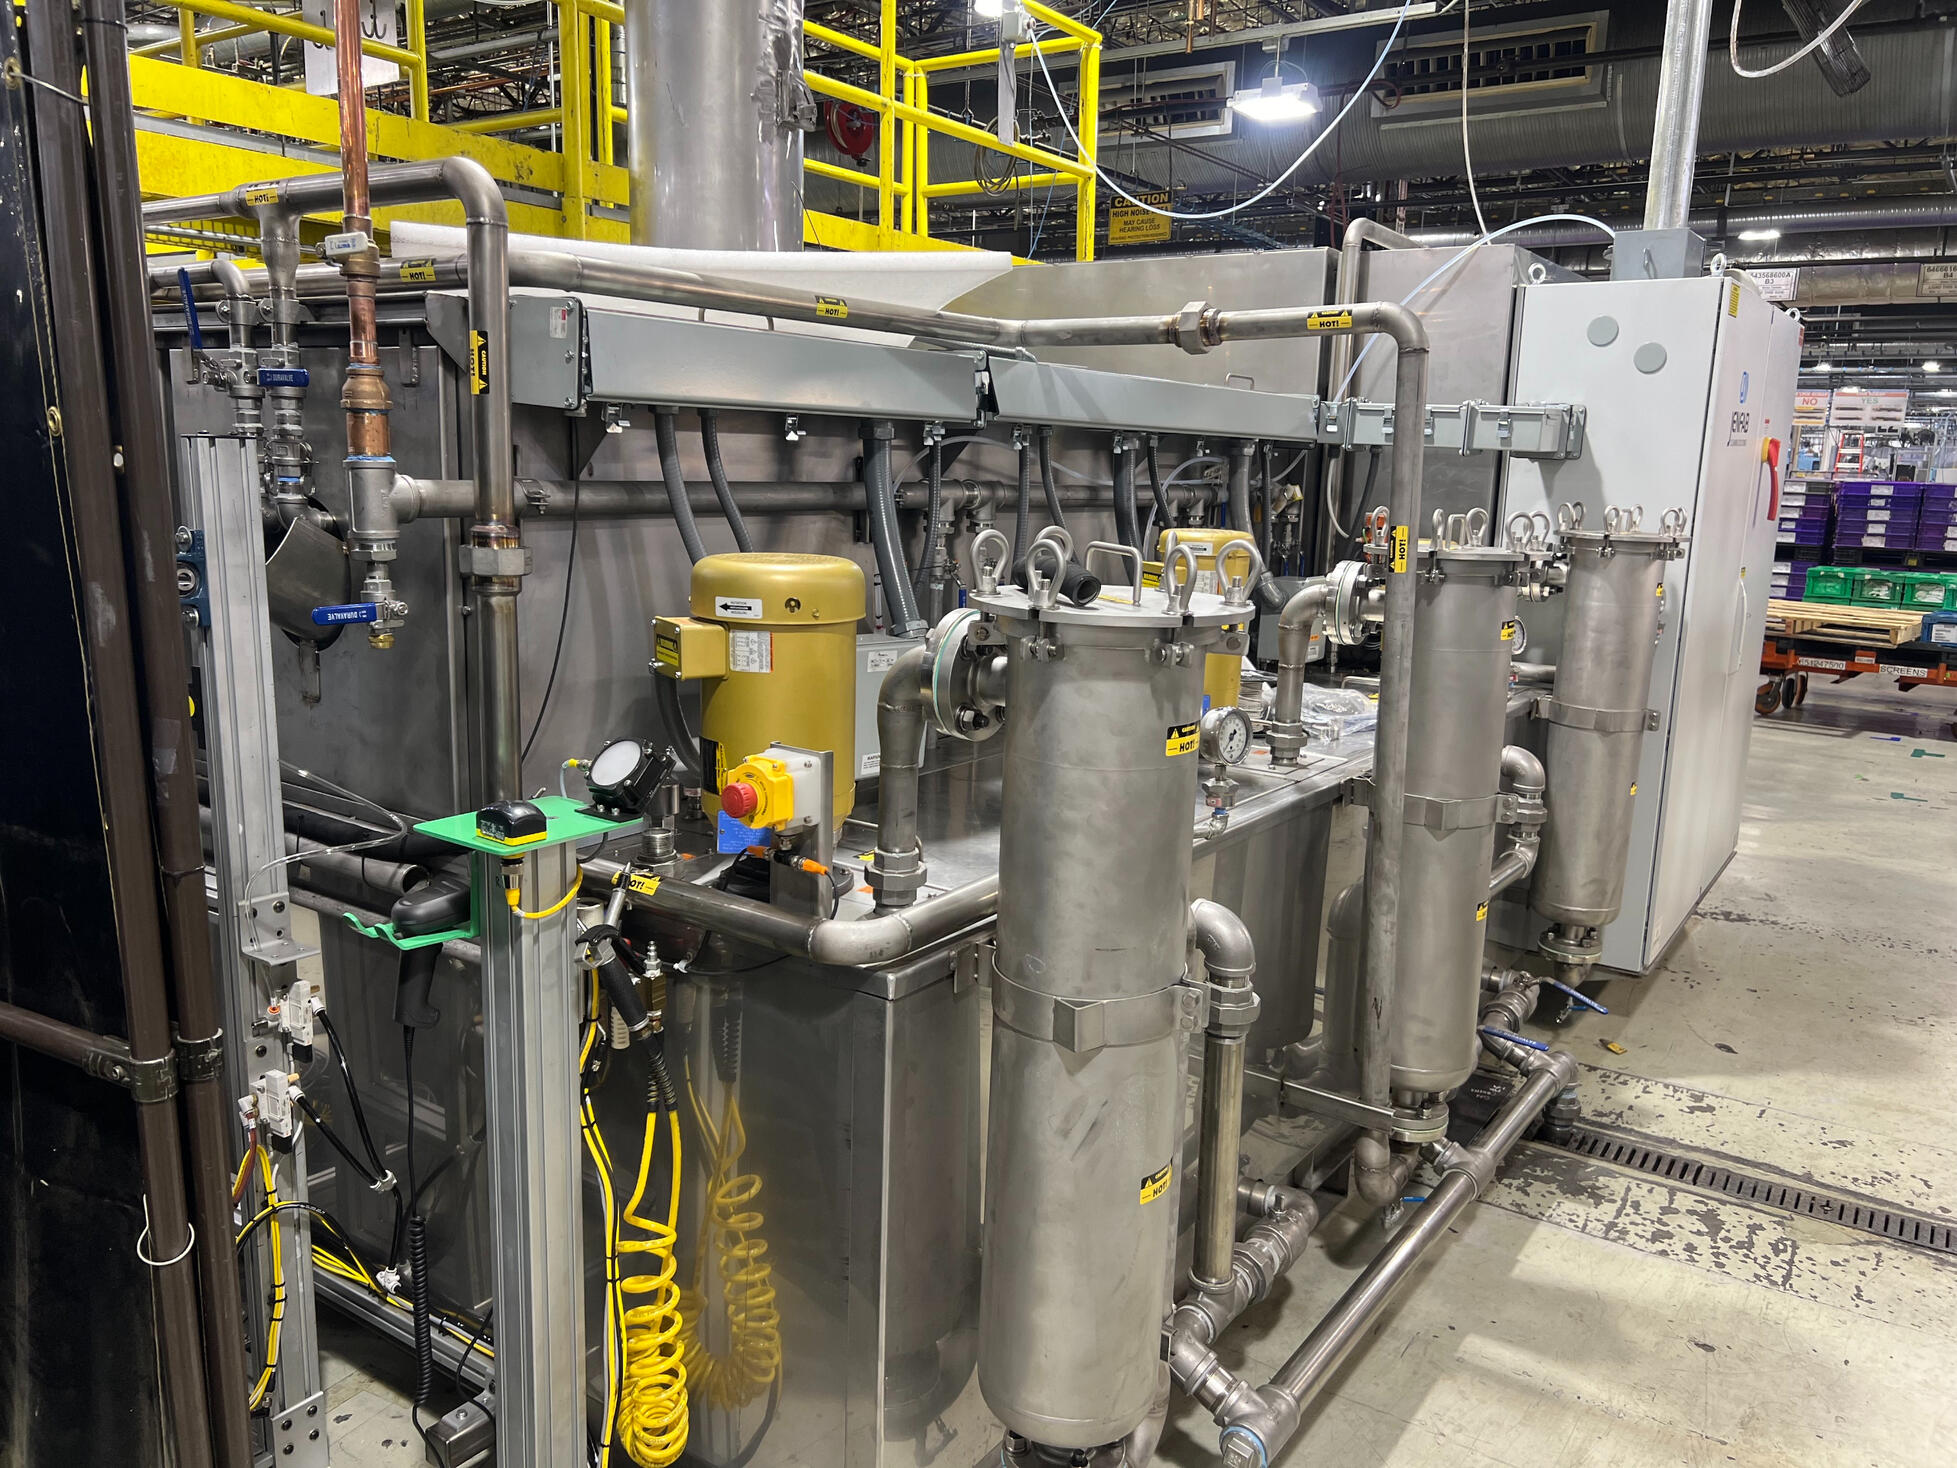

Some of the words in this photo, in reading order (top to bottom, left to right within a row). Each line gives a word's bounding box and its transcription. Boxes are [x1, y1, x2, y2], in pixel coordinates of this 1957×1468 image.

[1114, 192, 1169, 208] CATION
[1112, 210, 1129, 218] HIGH
[409, 271, 427, 281] HOT!
[824, 307, 840, 316] HOT!
[1319, 320, 1339, 328] HOT!
[1801, 398, 1818, 406] NO
[1398, 539, 1407, 560] HOT!
[327, 611, 358, 621] DURAVALVE
[1880, 664, 1927, 677] SCREENS
[1179, 740, 1196, 753] HOT!
[629, 879, 645, 890] OT!
[1152, 1179, 1168, 1198] HOT!
